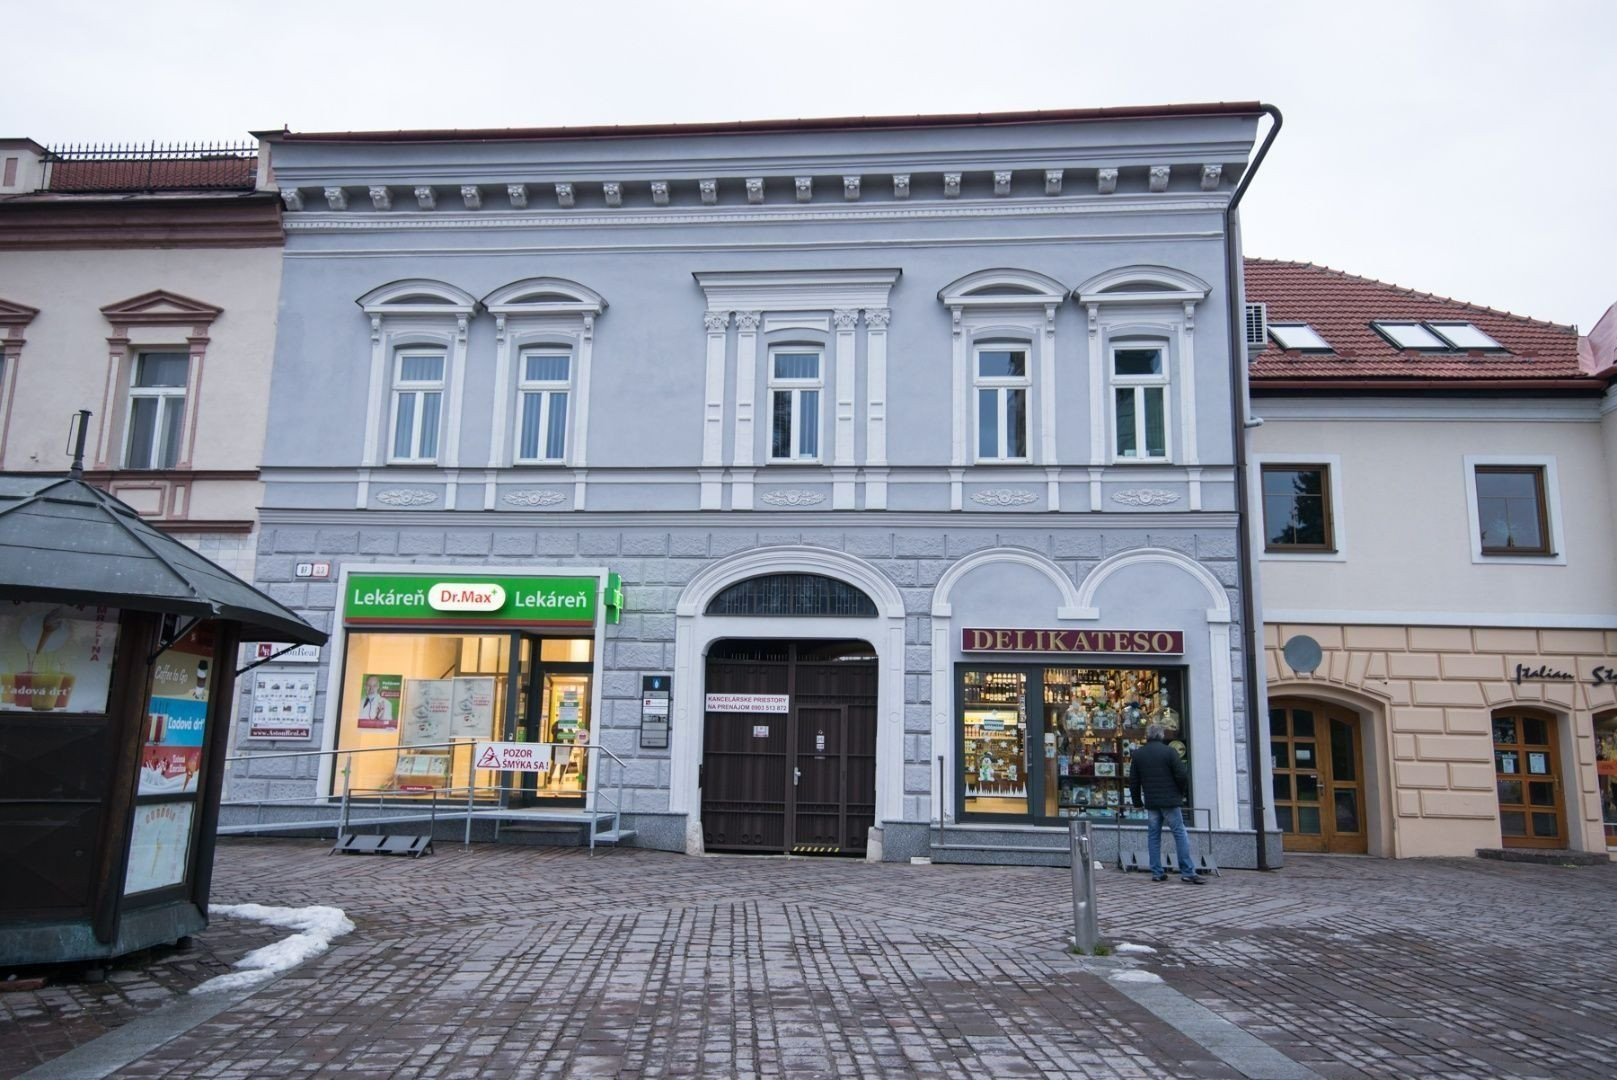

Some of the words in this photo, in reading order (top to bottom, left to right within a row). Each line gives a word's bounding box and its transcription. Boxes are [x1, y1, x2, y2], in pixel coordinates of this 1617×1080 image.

[354, 588, 425, 606] Lekáreň
[440, 590, 492, 604] Dr.Max
[515, 590, 587, 608] Lekáreň
[971, 630, 1174, 652] DELIKATESO
[1516, 664, 1574, 685] Italian
[1592, 666, 1617, 687] St
[252, 729, 307, 737] www.AstonReal.sk
[503, 748, 533, 758] POZOR
[502, 759, 532, 770] ŠMÝKA
